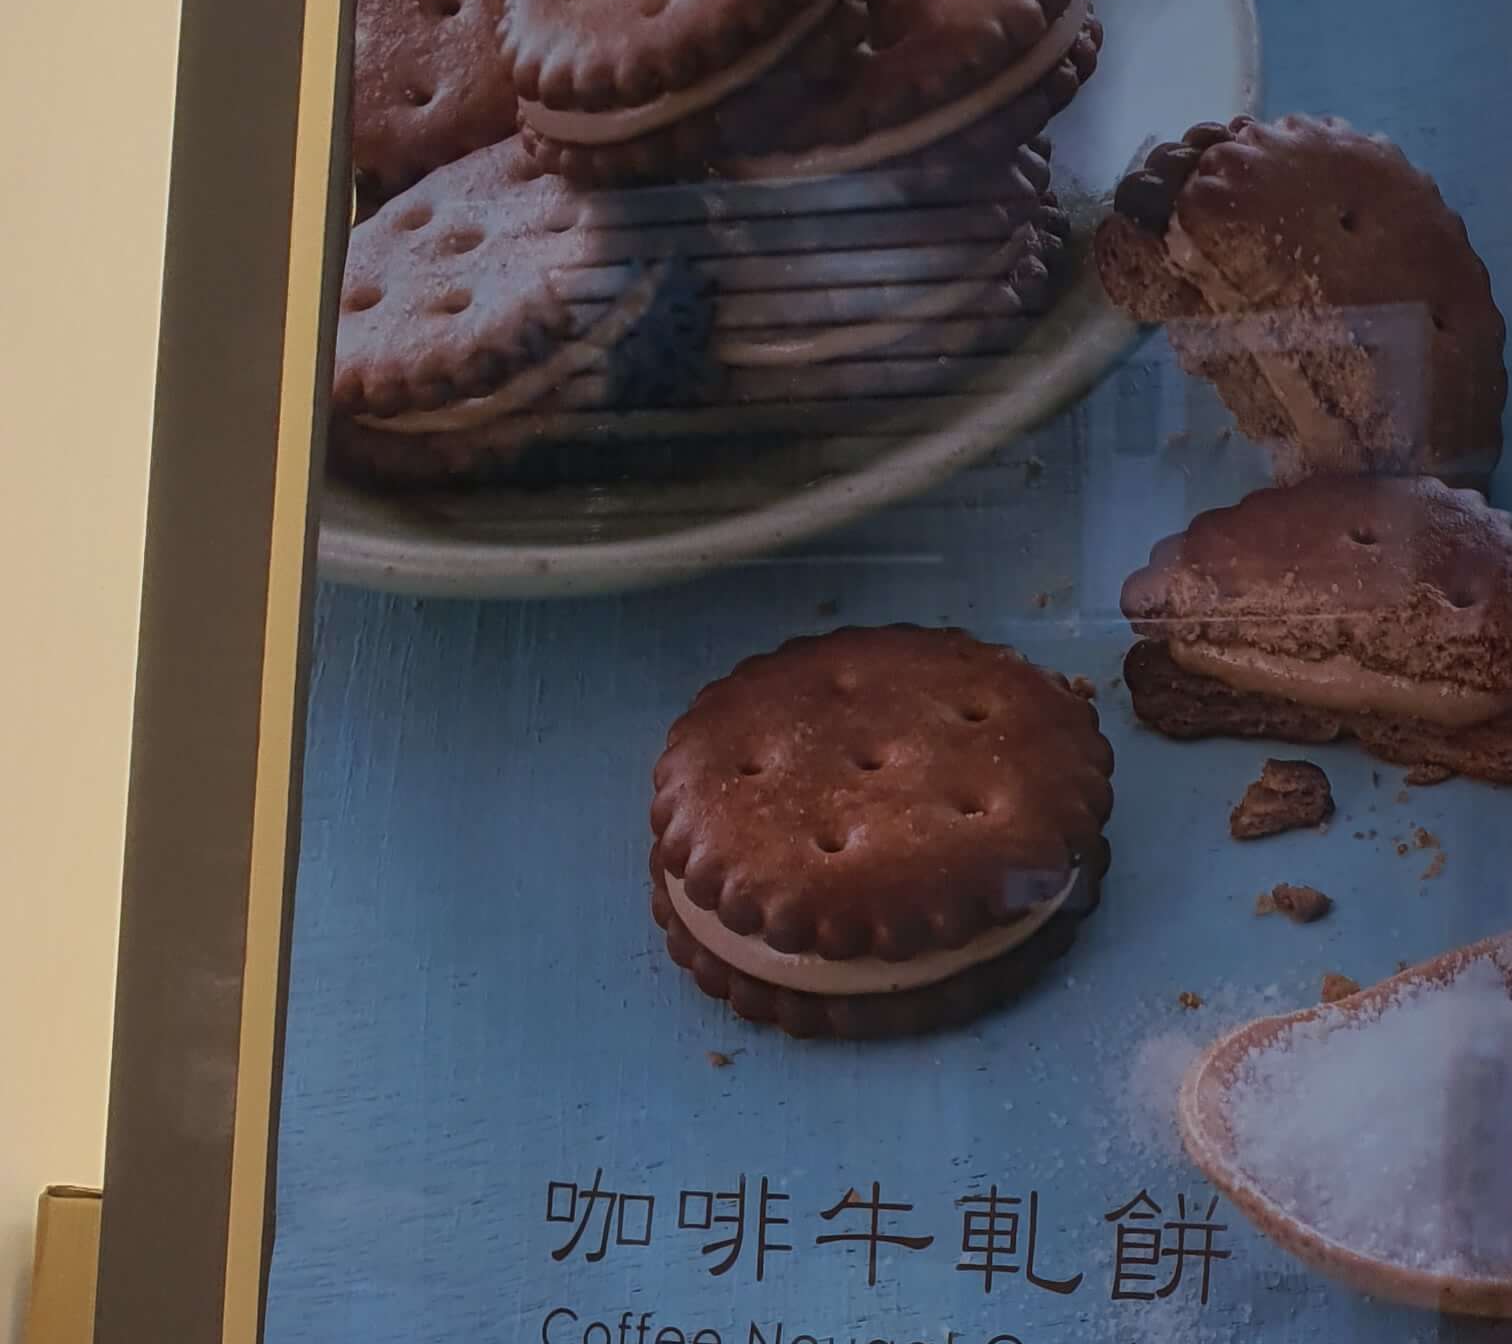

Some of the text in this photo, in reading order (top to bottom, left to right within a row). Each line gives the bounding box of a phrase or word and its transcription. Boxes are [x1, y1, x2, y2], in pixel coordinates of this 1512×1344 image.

[546, 1167, 1233, 1305] 咖啡牛軋餅
